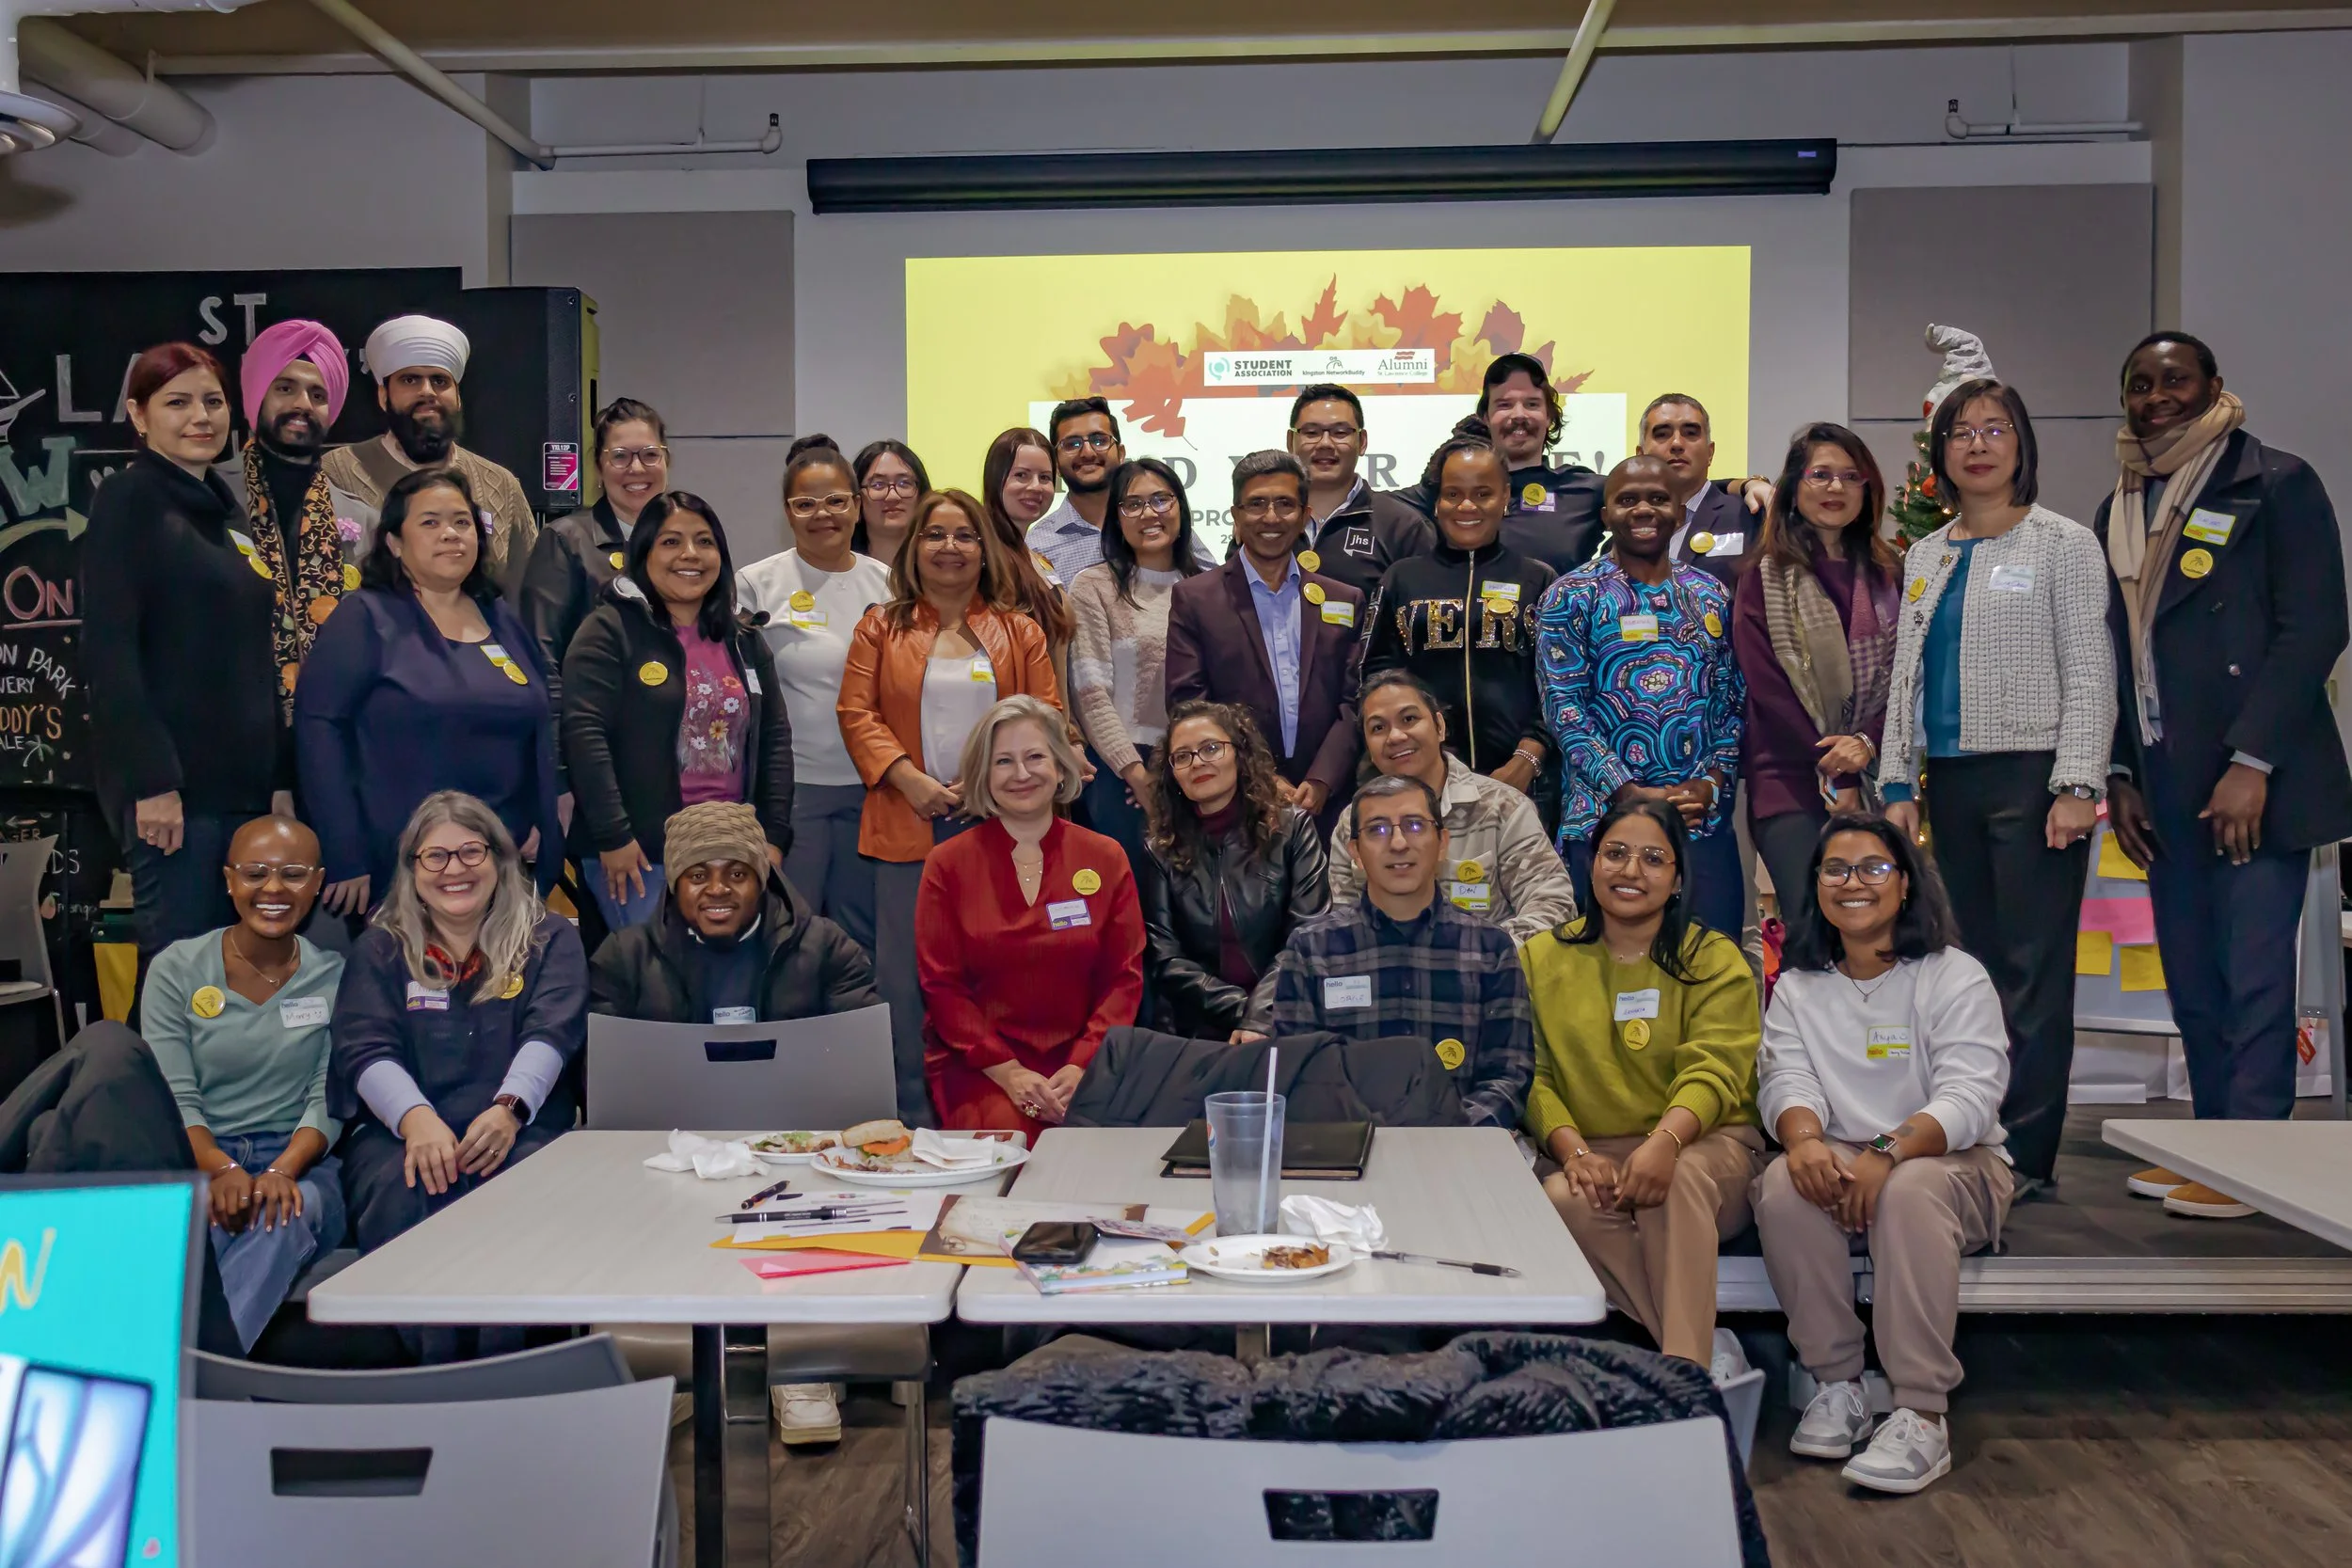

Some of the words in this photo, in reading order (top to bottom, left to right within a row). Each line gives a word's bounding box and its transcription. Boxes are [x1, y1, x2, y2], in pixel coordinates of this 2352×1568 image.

[198, 293, 267, 346] ST
[1234, 359, 1293, 370] STUDENT
[1377, 357, 1428, 371] Alumni
[1234, 369, 1293, 377] ASSOCIATION
[1349, 534, 1370, 546] jhs
[26, 646, 76, 700] PARK
